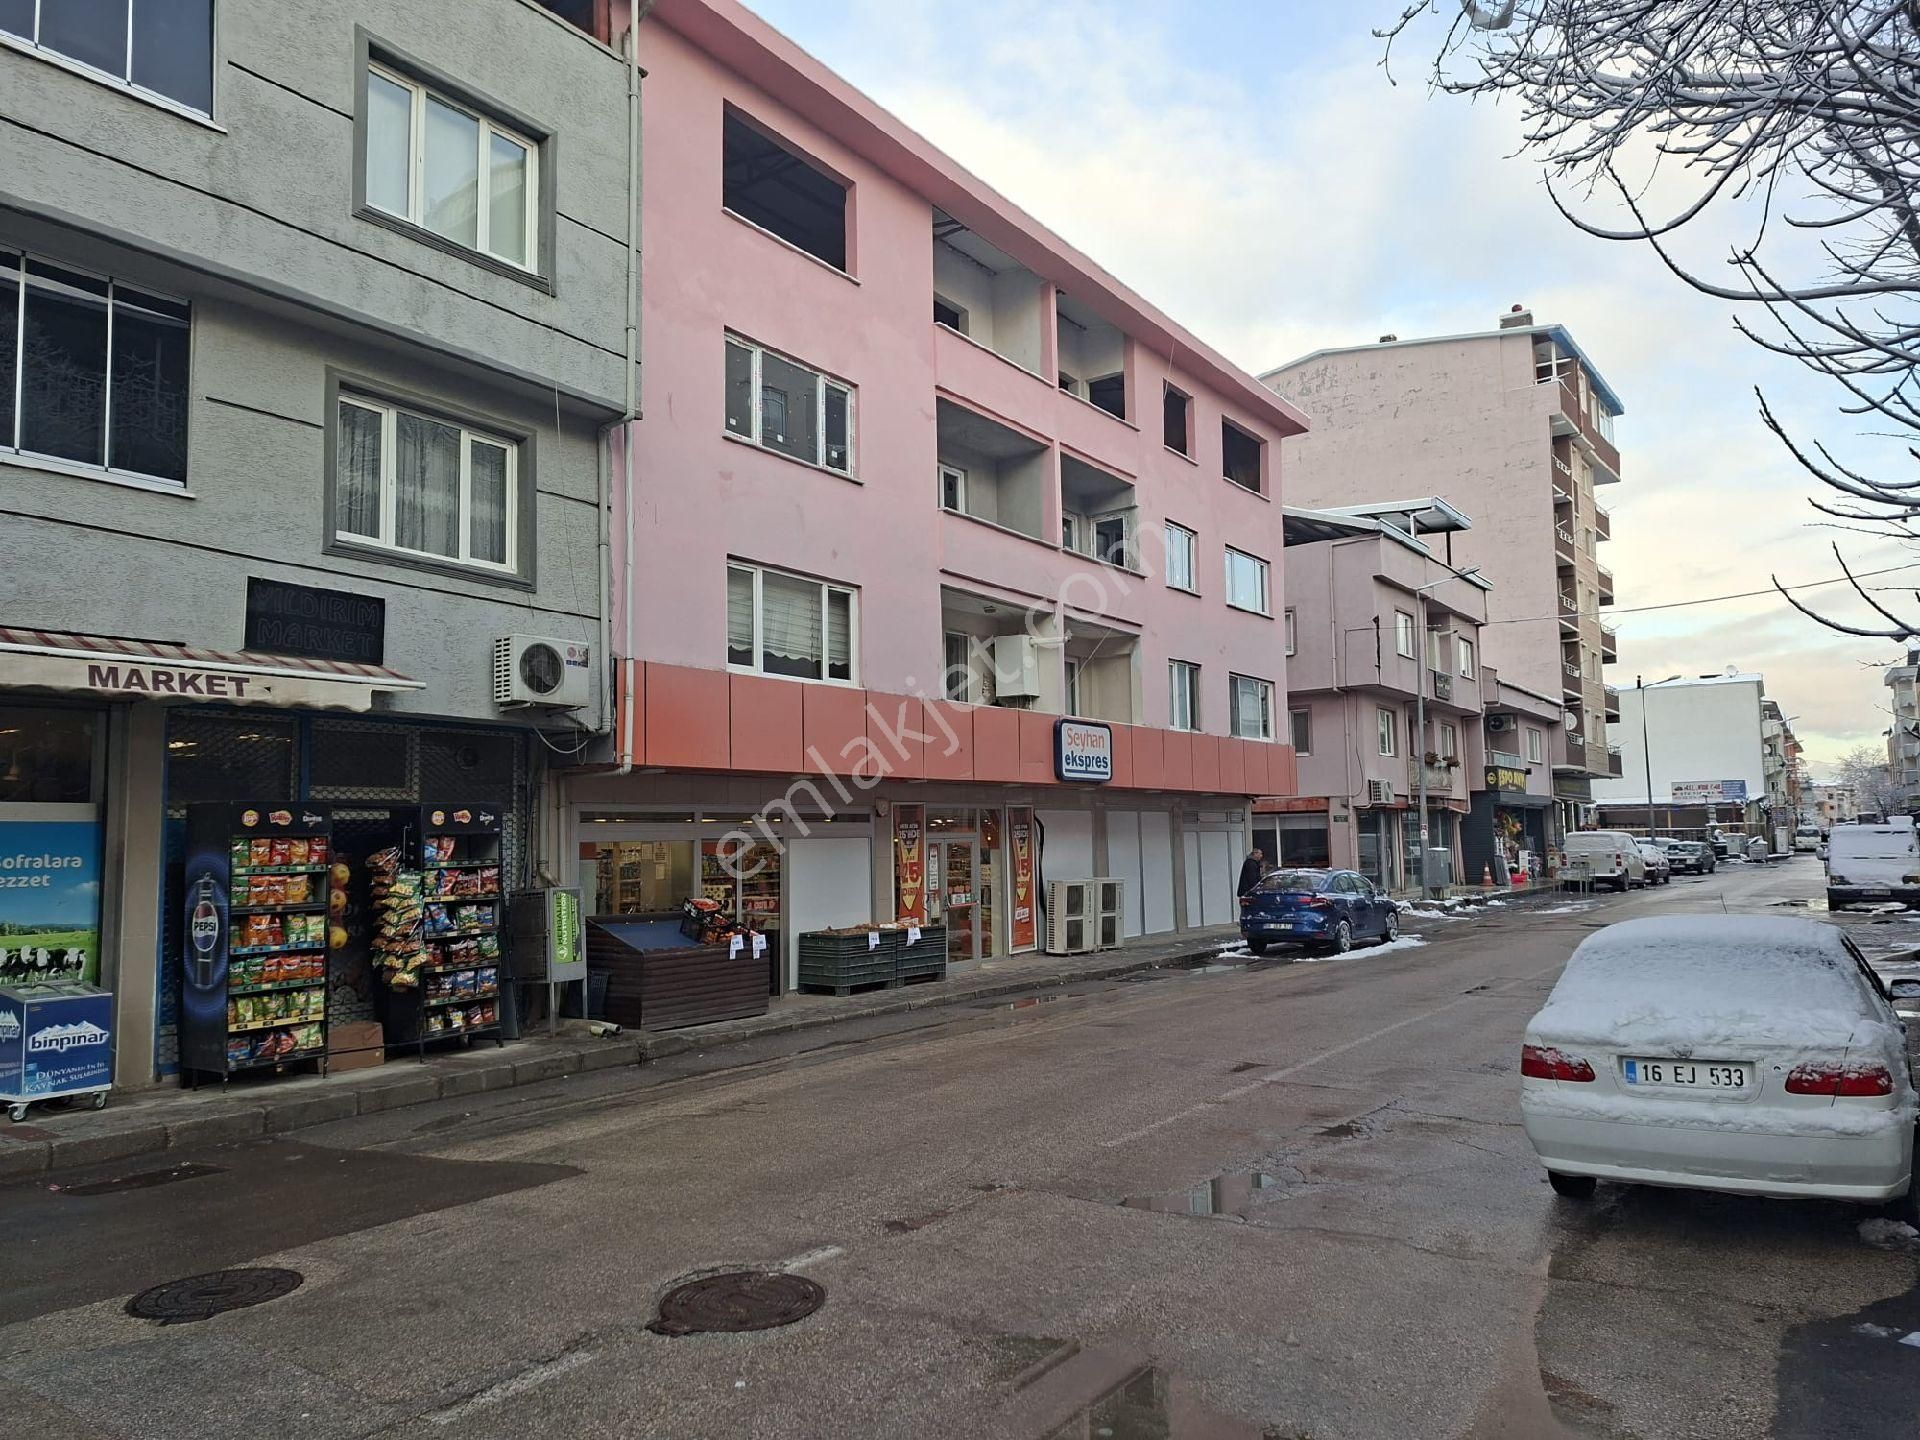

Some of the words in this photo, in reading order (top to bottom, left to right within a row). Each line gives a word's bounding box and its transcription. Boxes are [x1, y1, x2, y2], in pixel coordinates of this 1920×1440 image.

[253, 584, 380, 628] YILDIRIM
[257, 617, 376, 657] MARKET
[88, 664, 250, 698] MARKET
[1066, 727, 1105, 752] Seyhan
[1064, 750, 1109, 772] ekspres
[0, 854, 82, 869] ofralara
[194, 921, 216, 932] PEPSI
[1643, 1064, 1662, 1082] 16
[1673, 1066, 1696, 1084] EJ
[1709, 1067, 1745, 1087] 533
